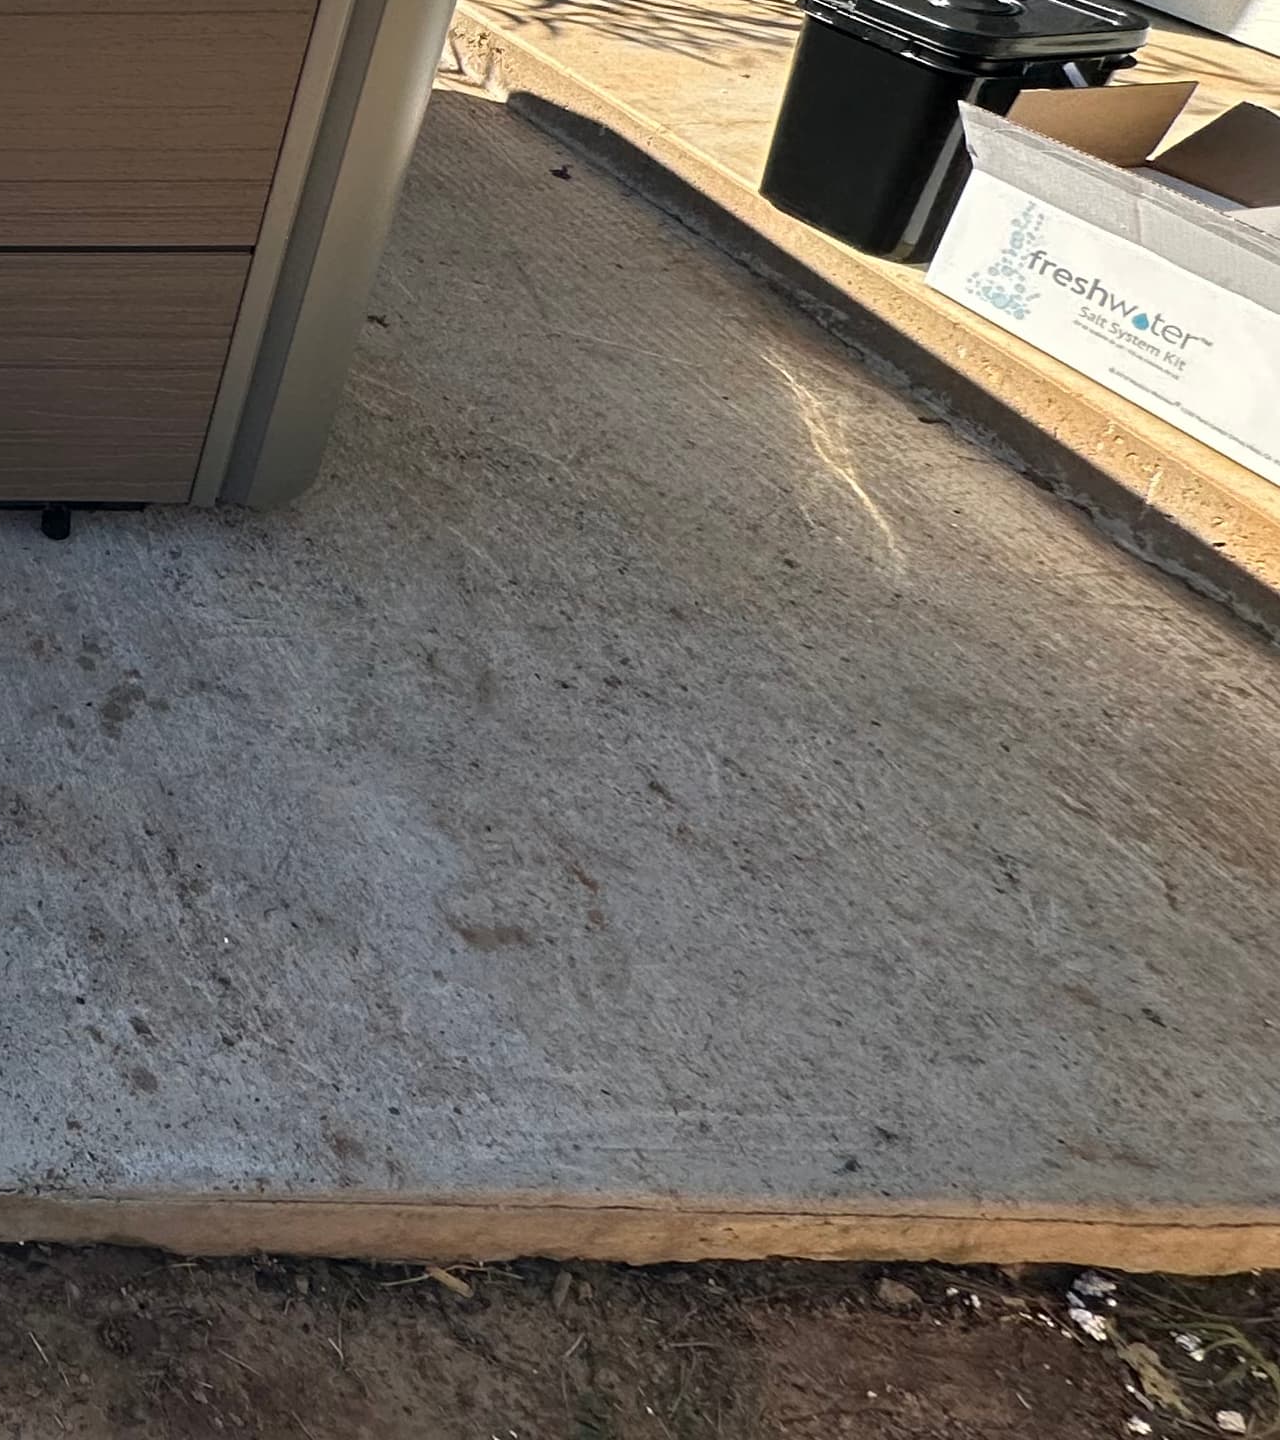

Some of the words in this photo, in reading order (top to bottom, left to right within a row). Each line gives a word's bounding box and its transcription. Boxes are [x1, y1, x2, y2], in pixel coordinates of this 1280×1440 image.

[1077, 306, 1108, 329] Salt
[1108, 321, 1161, 356] System
[1162, 351, 1187, 372] Kit
